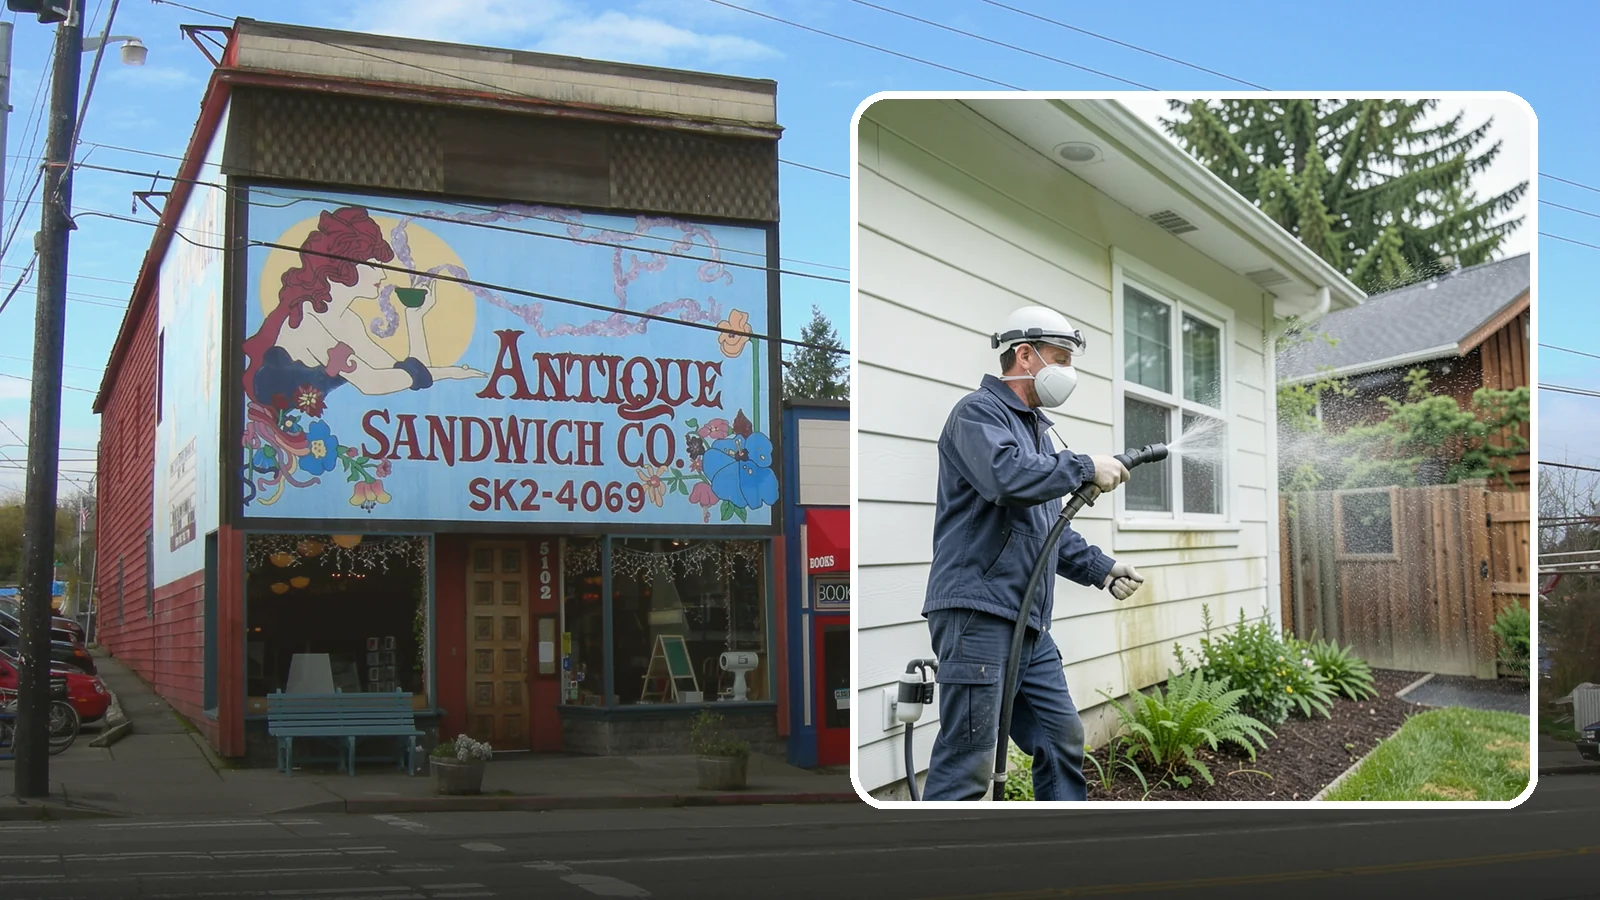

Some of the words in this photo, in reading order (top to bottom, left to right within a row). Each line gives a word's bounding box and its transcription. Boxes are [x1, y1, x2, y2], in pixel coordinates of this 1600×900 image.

[475, 329, 723, 421] ANTIQUE
[361, 408, 605, 468] SANDWICH
[616, 421, 685, 470] CO.
[468, 477, 646, 514] SK2-4069
[539, 541, 552, 600] 5102
[809, 555, 835, 569] BOOKS
